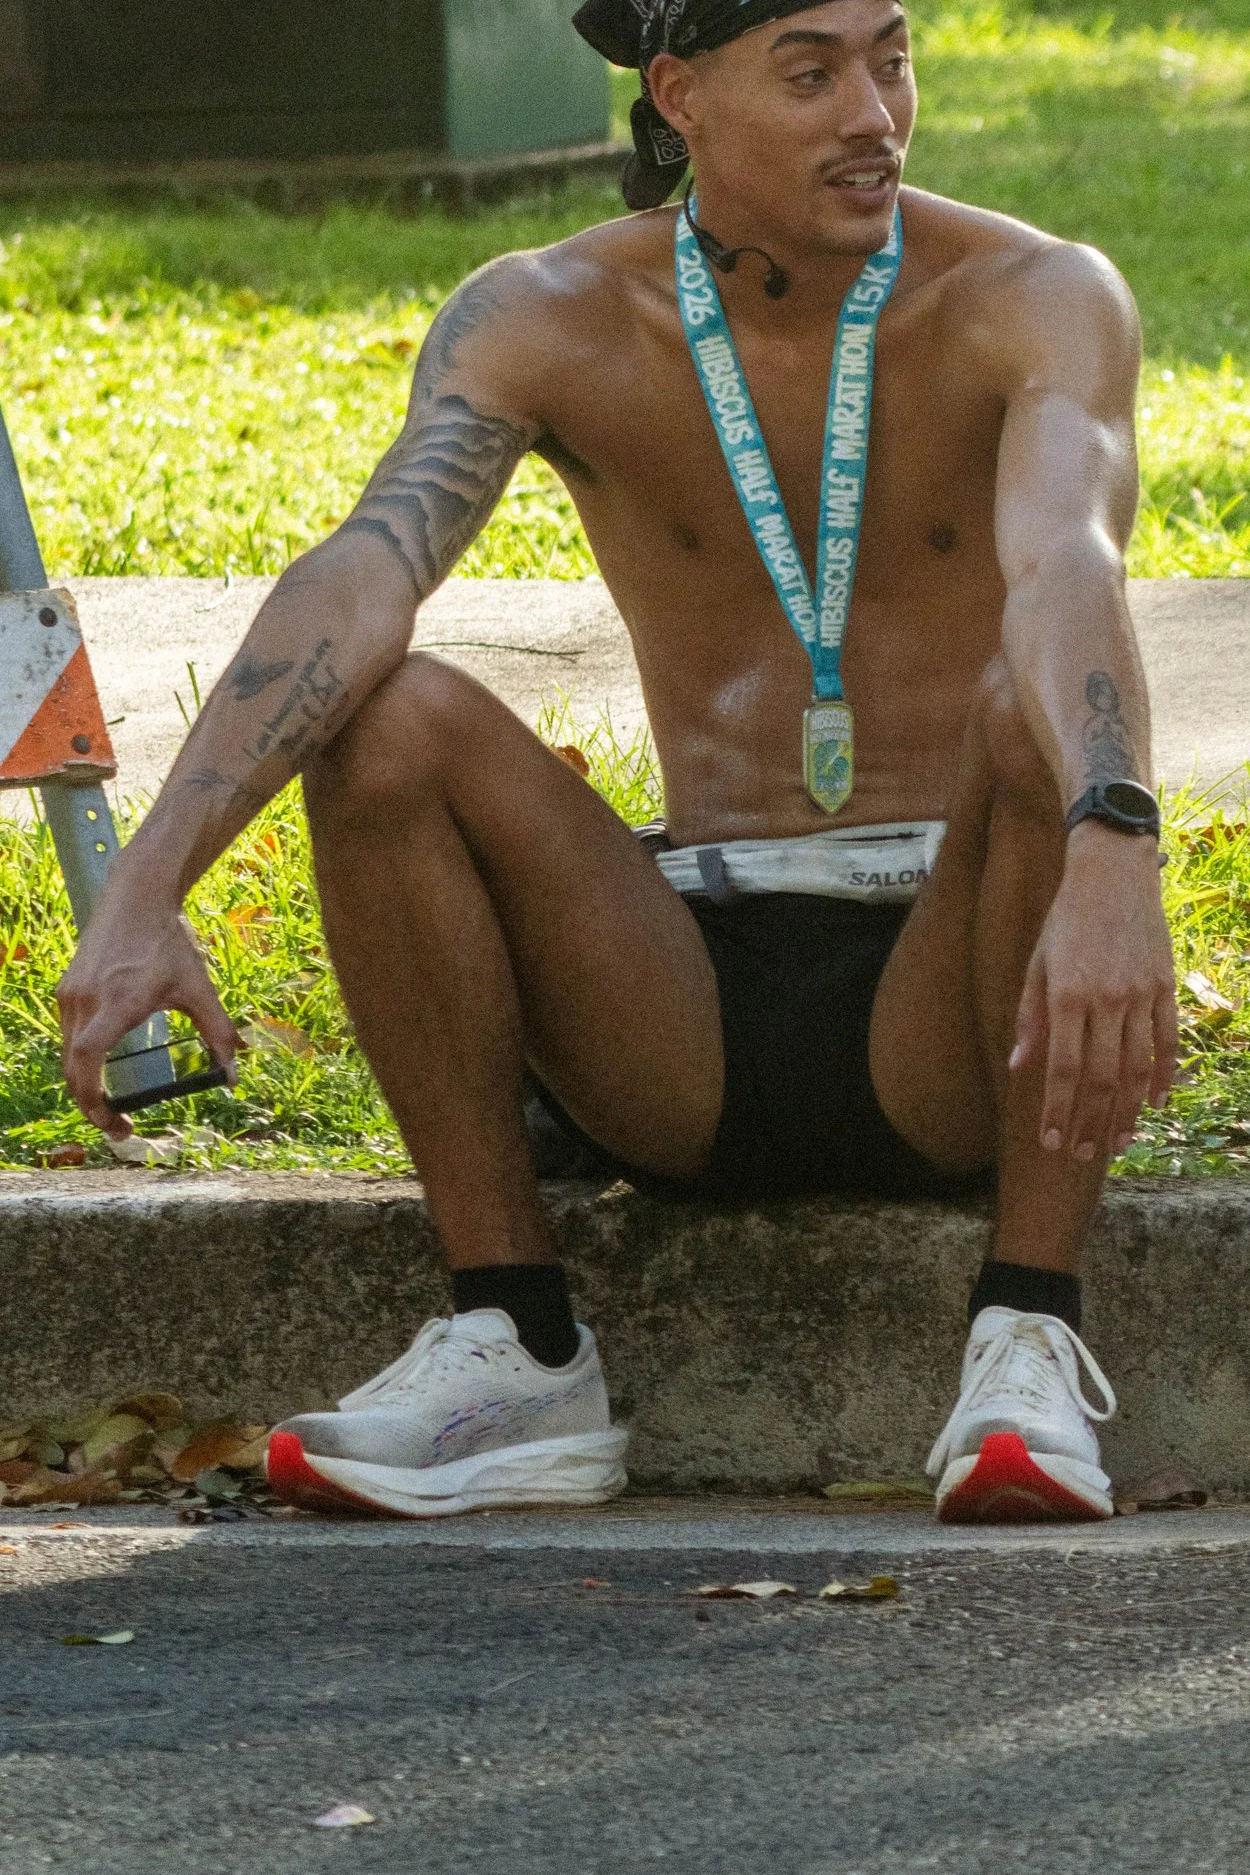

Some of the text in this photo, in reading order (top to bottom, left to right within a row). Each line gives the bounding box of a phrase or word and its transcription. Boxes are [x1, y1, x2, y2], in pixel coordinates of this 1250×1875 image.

[846, 263, 895, 315] 15K
[679, 248, 818, 643] 2026 HIBISCUS HALF MARATHON
[830, 323, 873, 461] MARATHON
[826, 467, 861, 529] HALF
[819, 536, 854, 649] HIBISCUS
